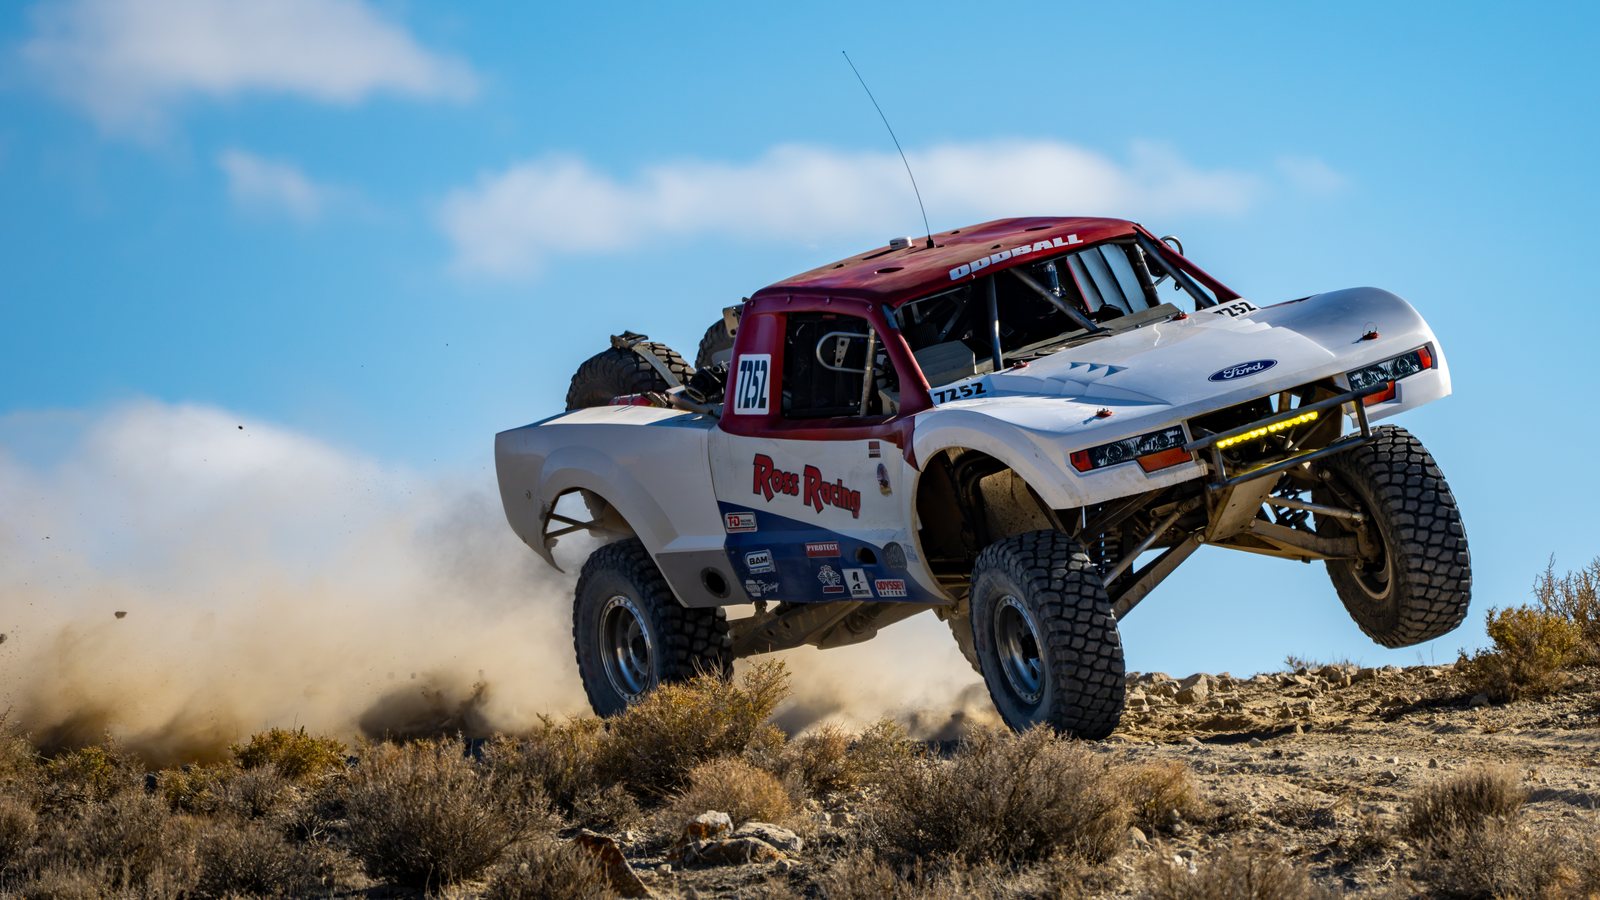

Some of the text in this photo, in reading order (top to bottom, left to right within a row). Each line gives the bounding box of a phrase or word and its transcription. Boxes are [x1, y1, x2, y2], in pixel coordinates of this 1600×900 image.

[949, 234, 1083, 281] ODDBALL
[1223, 362, 1264, 379] Ford
[738, 360, 767, 408] 7252
[934, 382, 987, 404] 7252
[753, 453, 861, 519] Ross Racing
[806, 543, 838, 552] PYROTECT
[749, 556, 767, 565] BAM
[876, 581, 905, 590] ODYSSEY
